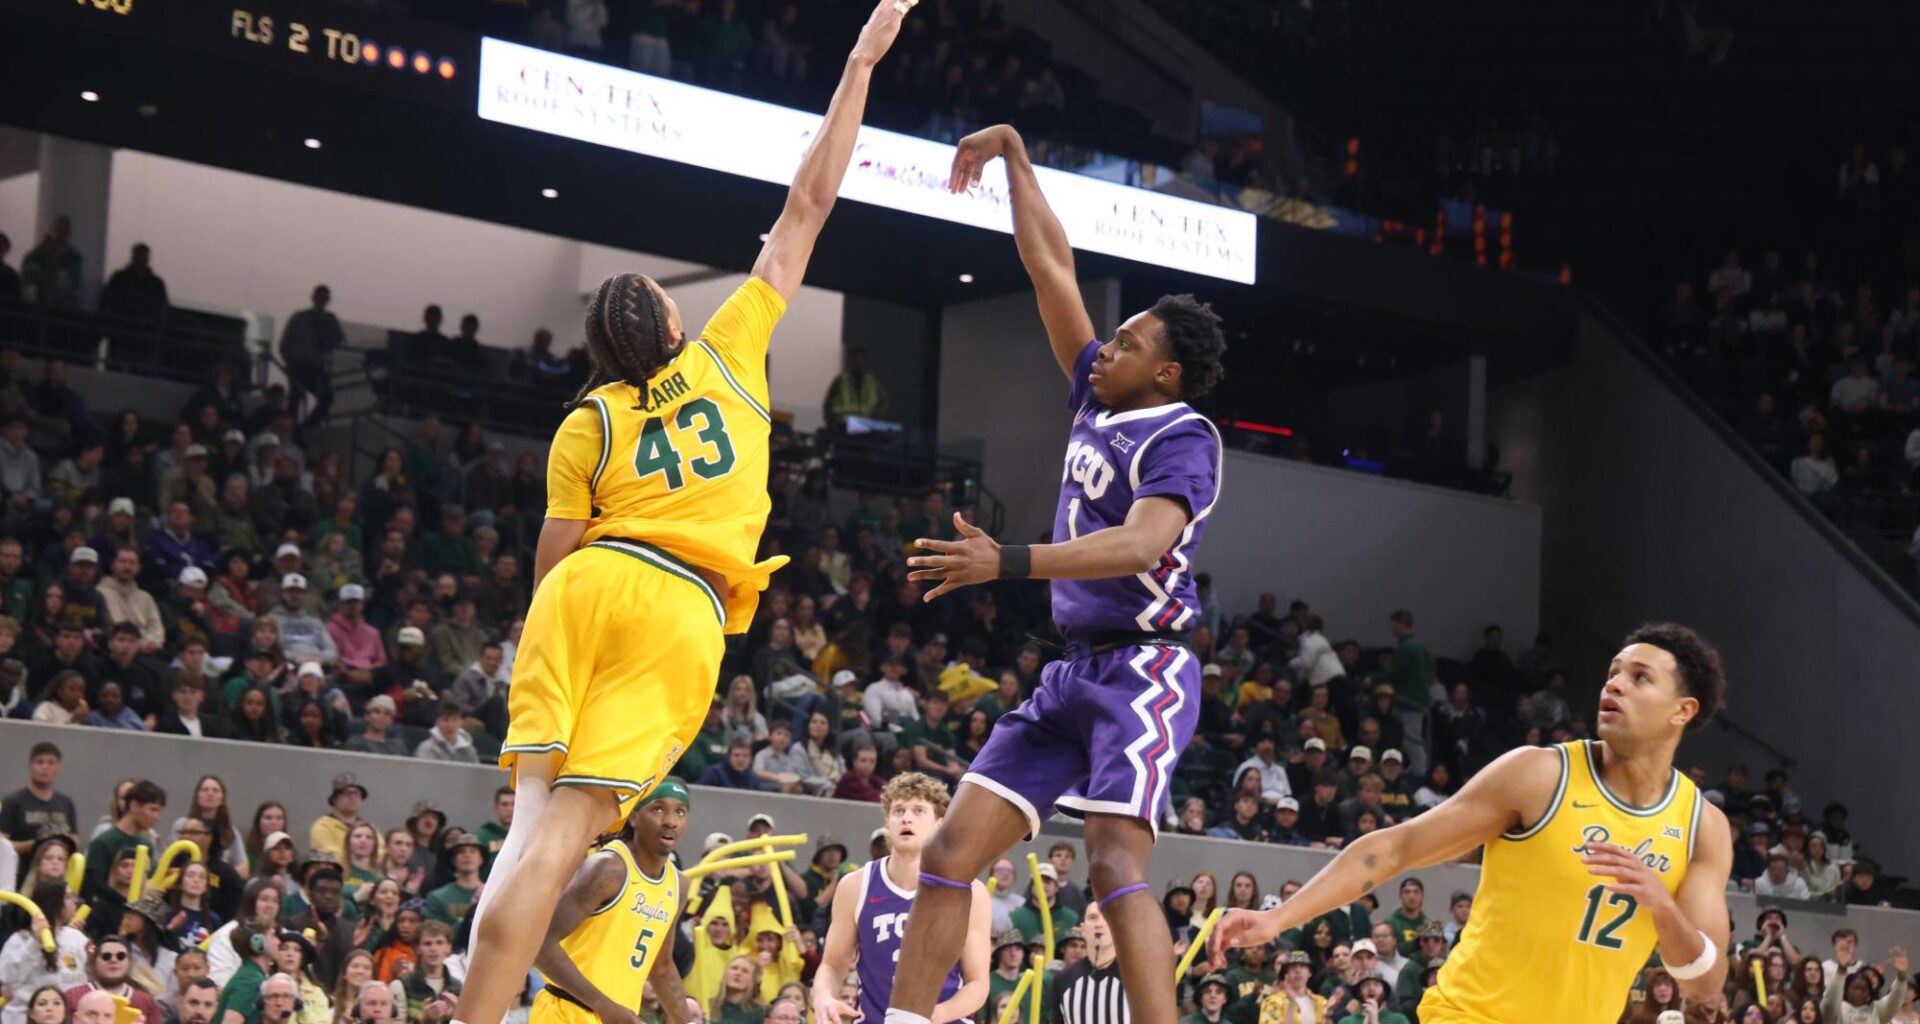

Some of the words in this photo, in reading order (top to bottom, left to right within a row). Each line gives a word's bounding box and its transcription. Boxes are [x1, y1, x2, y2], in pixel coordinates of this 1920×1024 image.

[231, 9, 273, 44] FLS
[288, 22, 310, 53] 2
[634, 396, 736, 492] 43
[630, 892, 670, 924] Baylor
[1576, 884, 1638, 951] 12
[629, 928, 655, 969] 5
